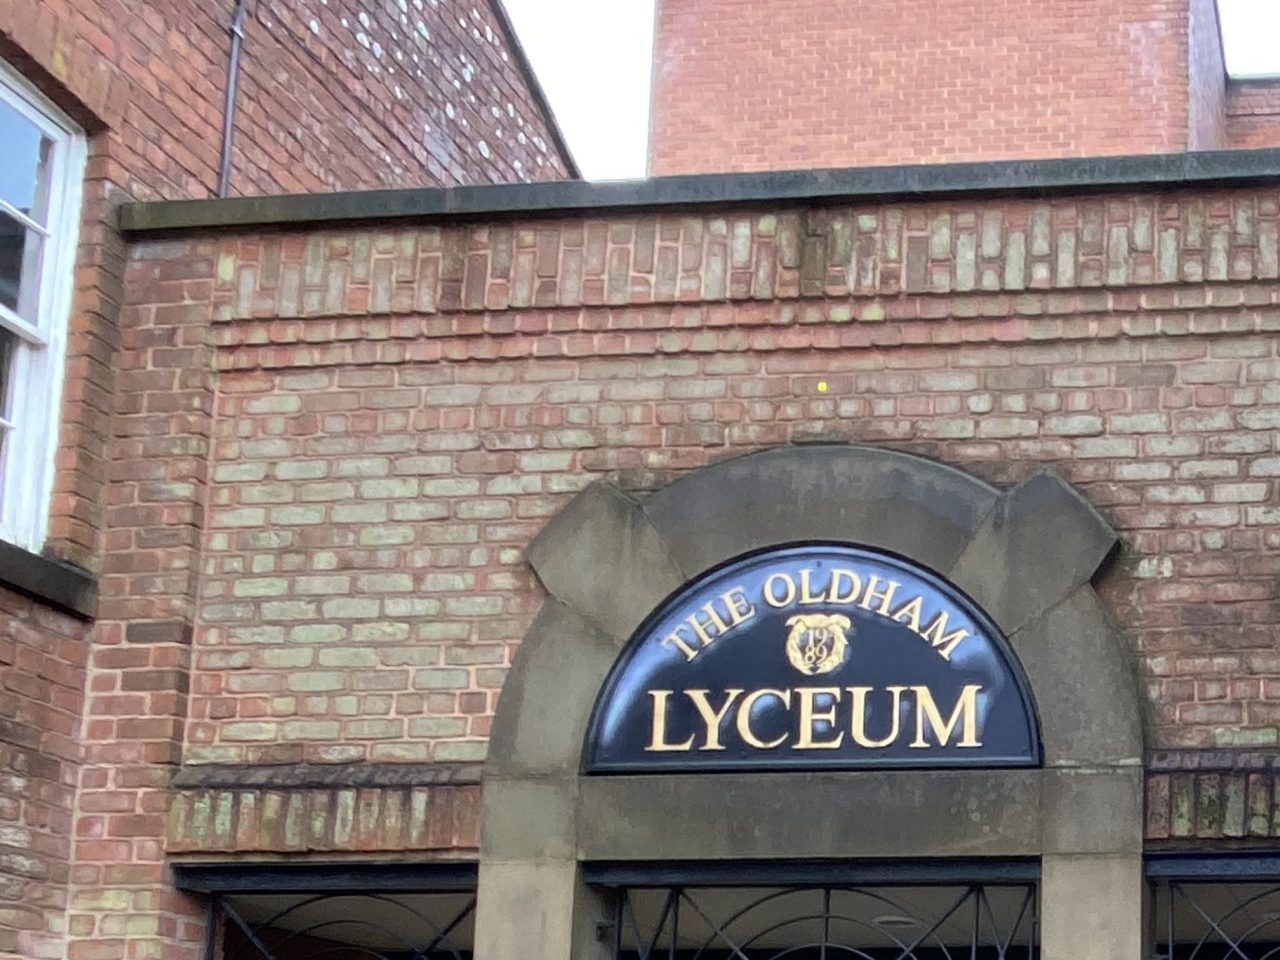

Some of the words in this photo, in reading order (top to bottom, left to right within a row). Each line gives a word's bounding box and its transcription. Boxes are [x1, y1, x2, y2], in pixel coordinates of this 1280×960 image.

[661, 585, 756, 663] THE
[763, 568, 969, 661] OLDHAM
[644, 684, 984, 751] LYCEUM
